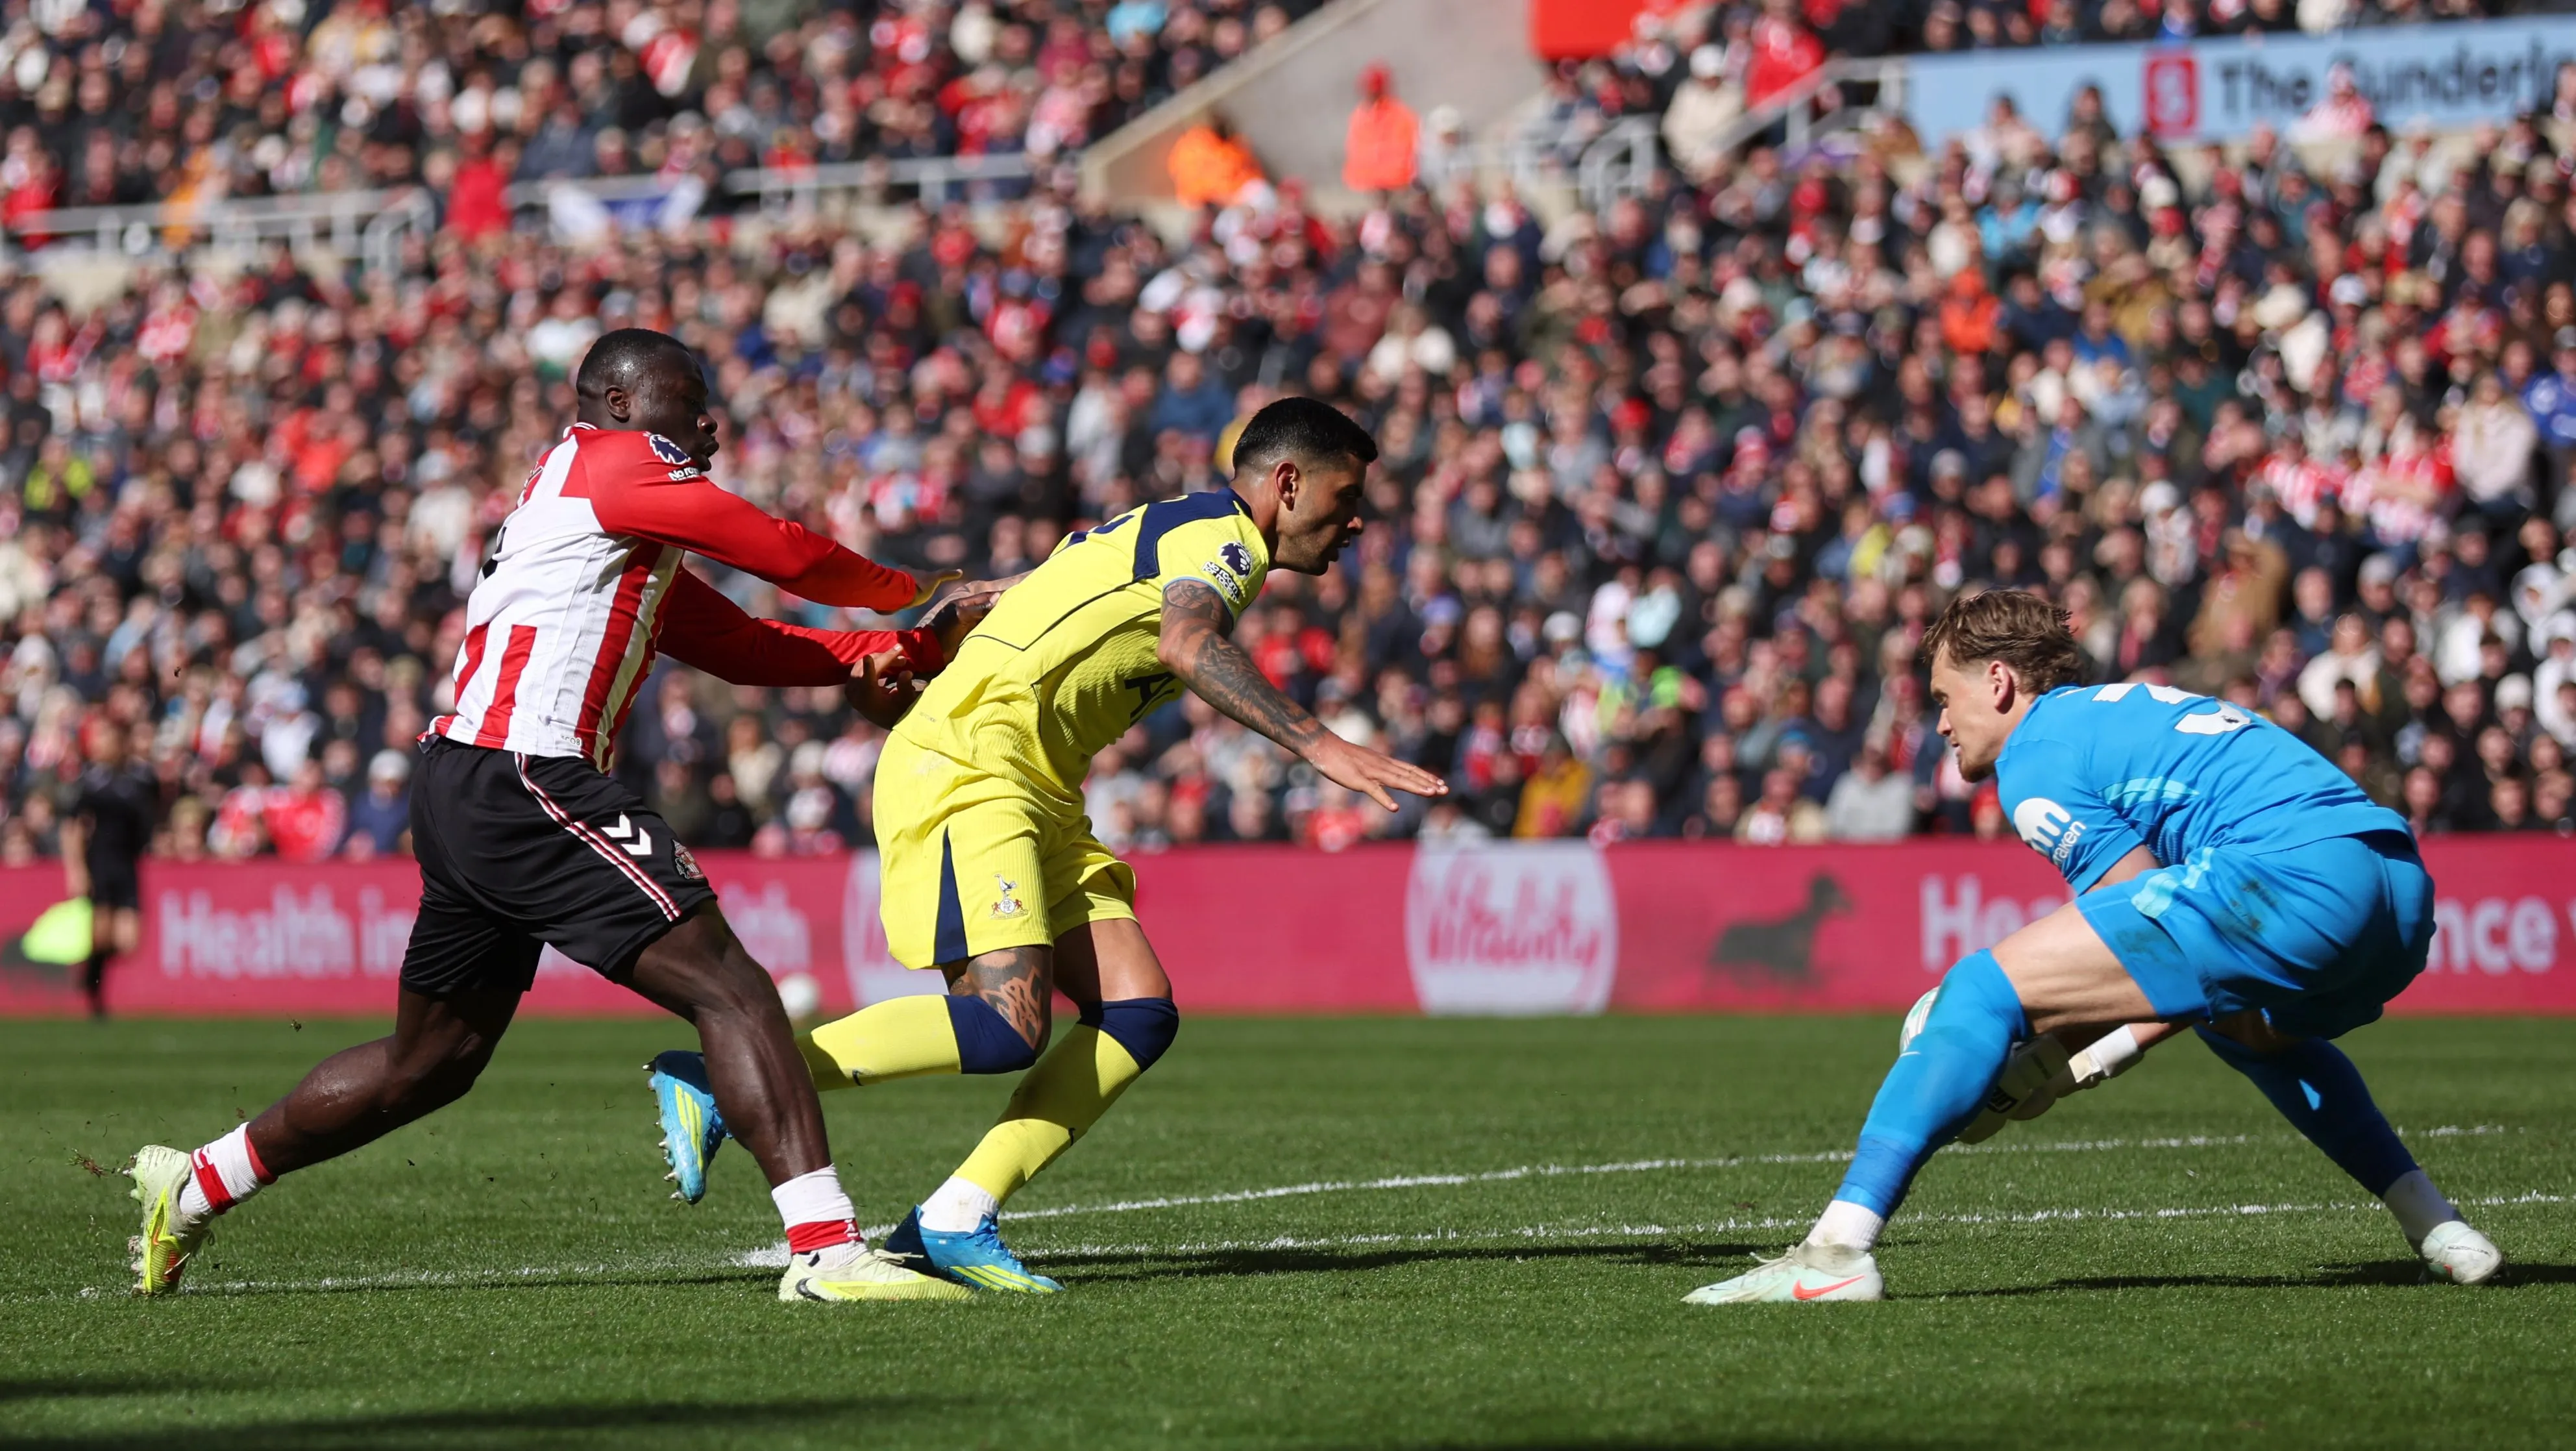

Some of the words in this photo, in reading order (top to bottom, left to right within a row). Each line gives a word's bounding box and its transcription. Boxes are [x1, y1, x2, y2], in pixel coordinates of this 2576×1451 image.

[2217, 57, 2309, 116] The
[668, 469, 684, 479] No
[1205, 561, 1220, 572] No
[1219, 569, 1238, 595] room
[2052, 821, 2087, 866] raken
[160, 883, 354, 979] Health
